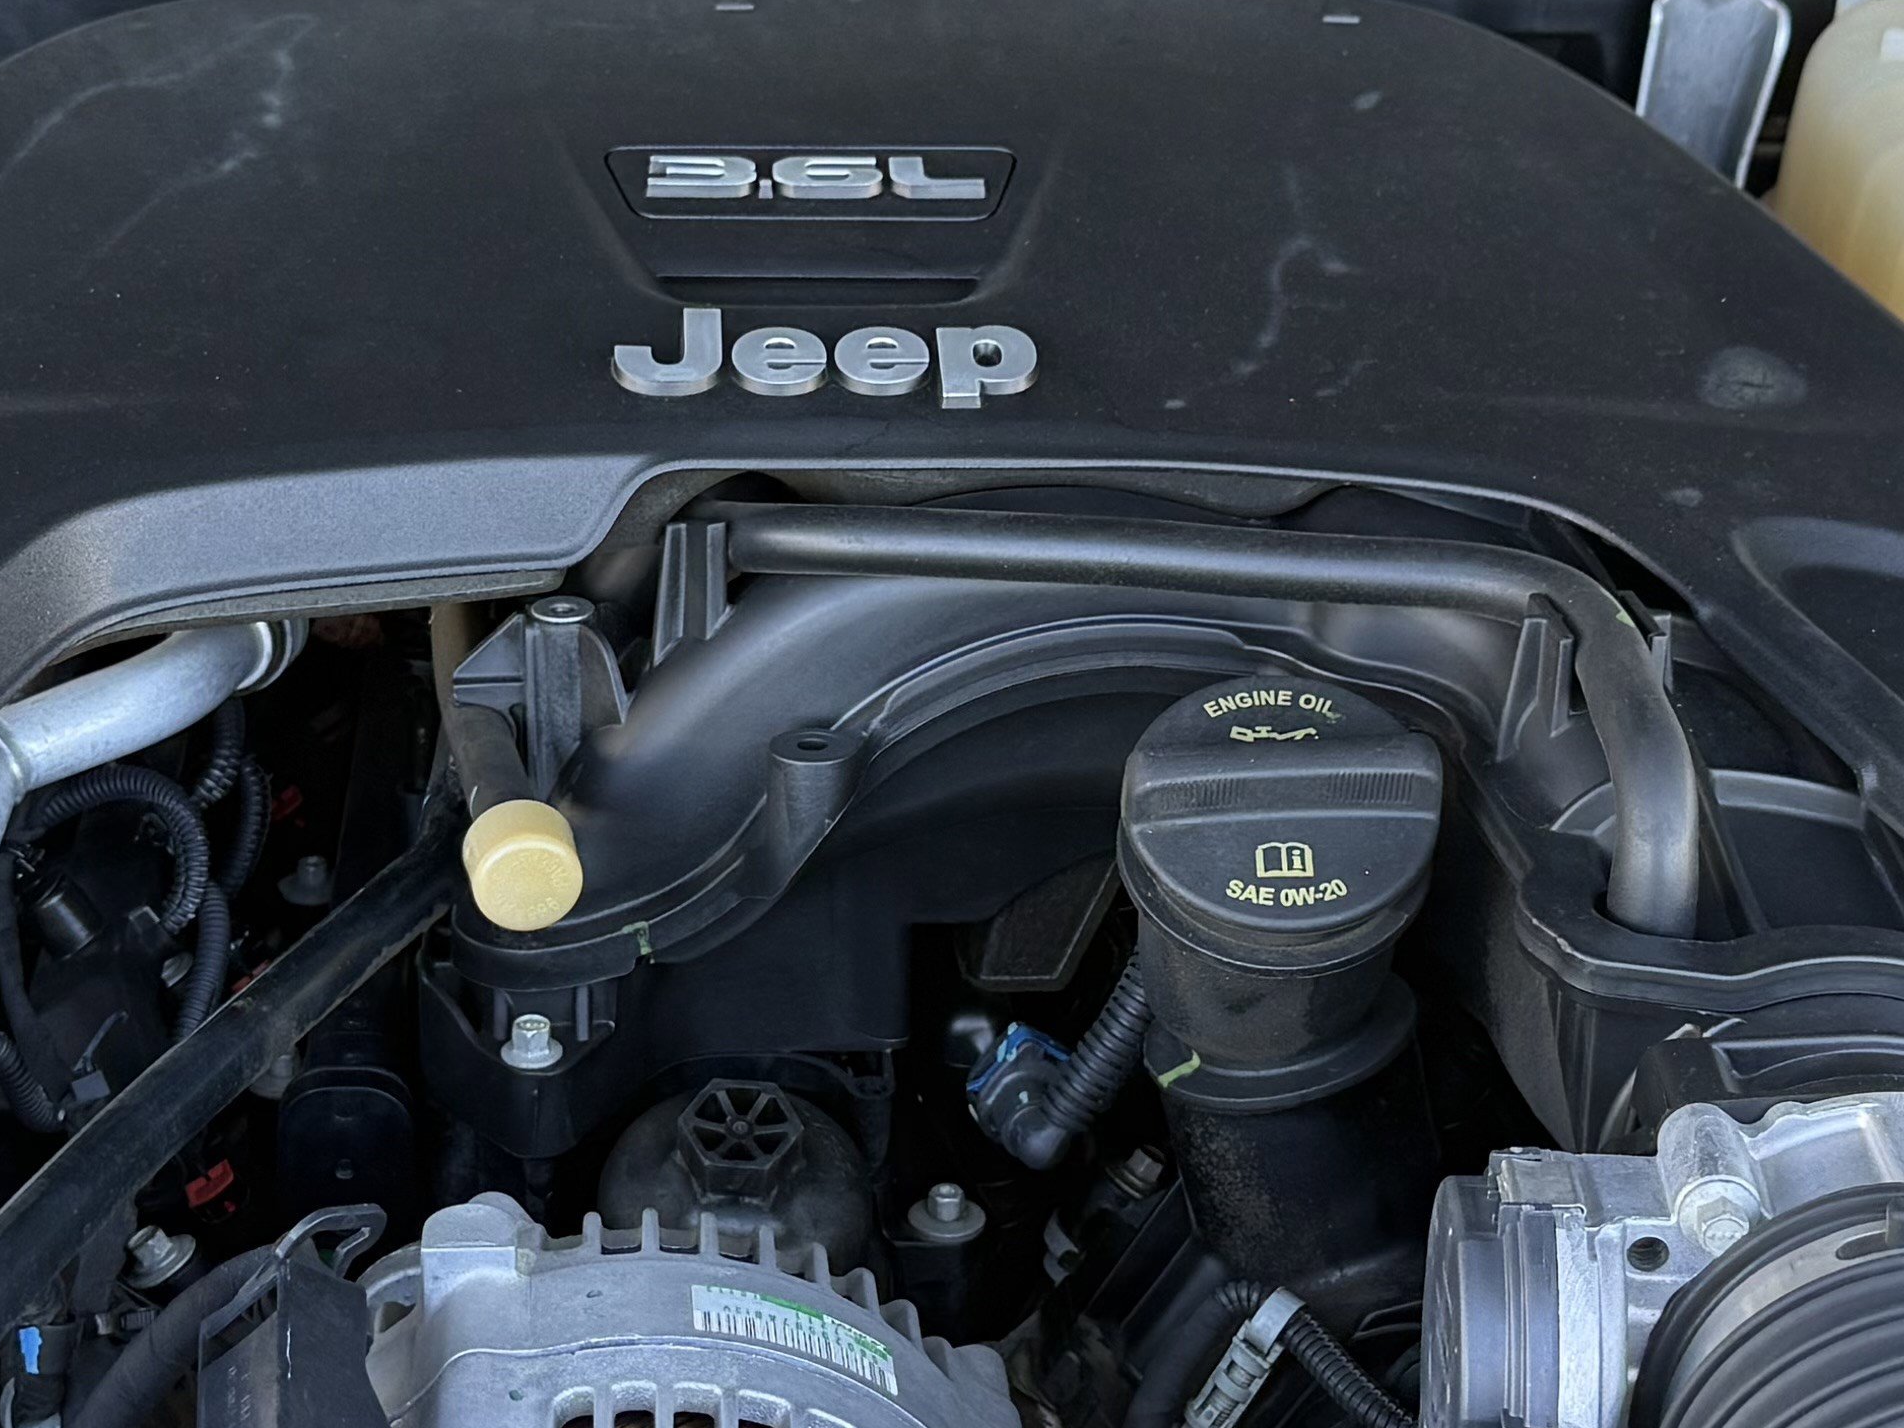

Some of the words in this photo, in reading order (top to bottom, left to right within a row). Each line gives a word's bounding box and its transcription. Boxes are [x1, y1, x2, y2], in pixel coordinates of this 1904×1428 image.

[645, 154, 986, 200] 3.6L
[609, 307, 1038, 409] Jeep
[1202, 689, 1292, 718] ENGINE
[1298, 693, 1337, 715] OIL
[1225, 879, 1275, 906] SAE
[1279, 878, 1348, 907] 0W-20
